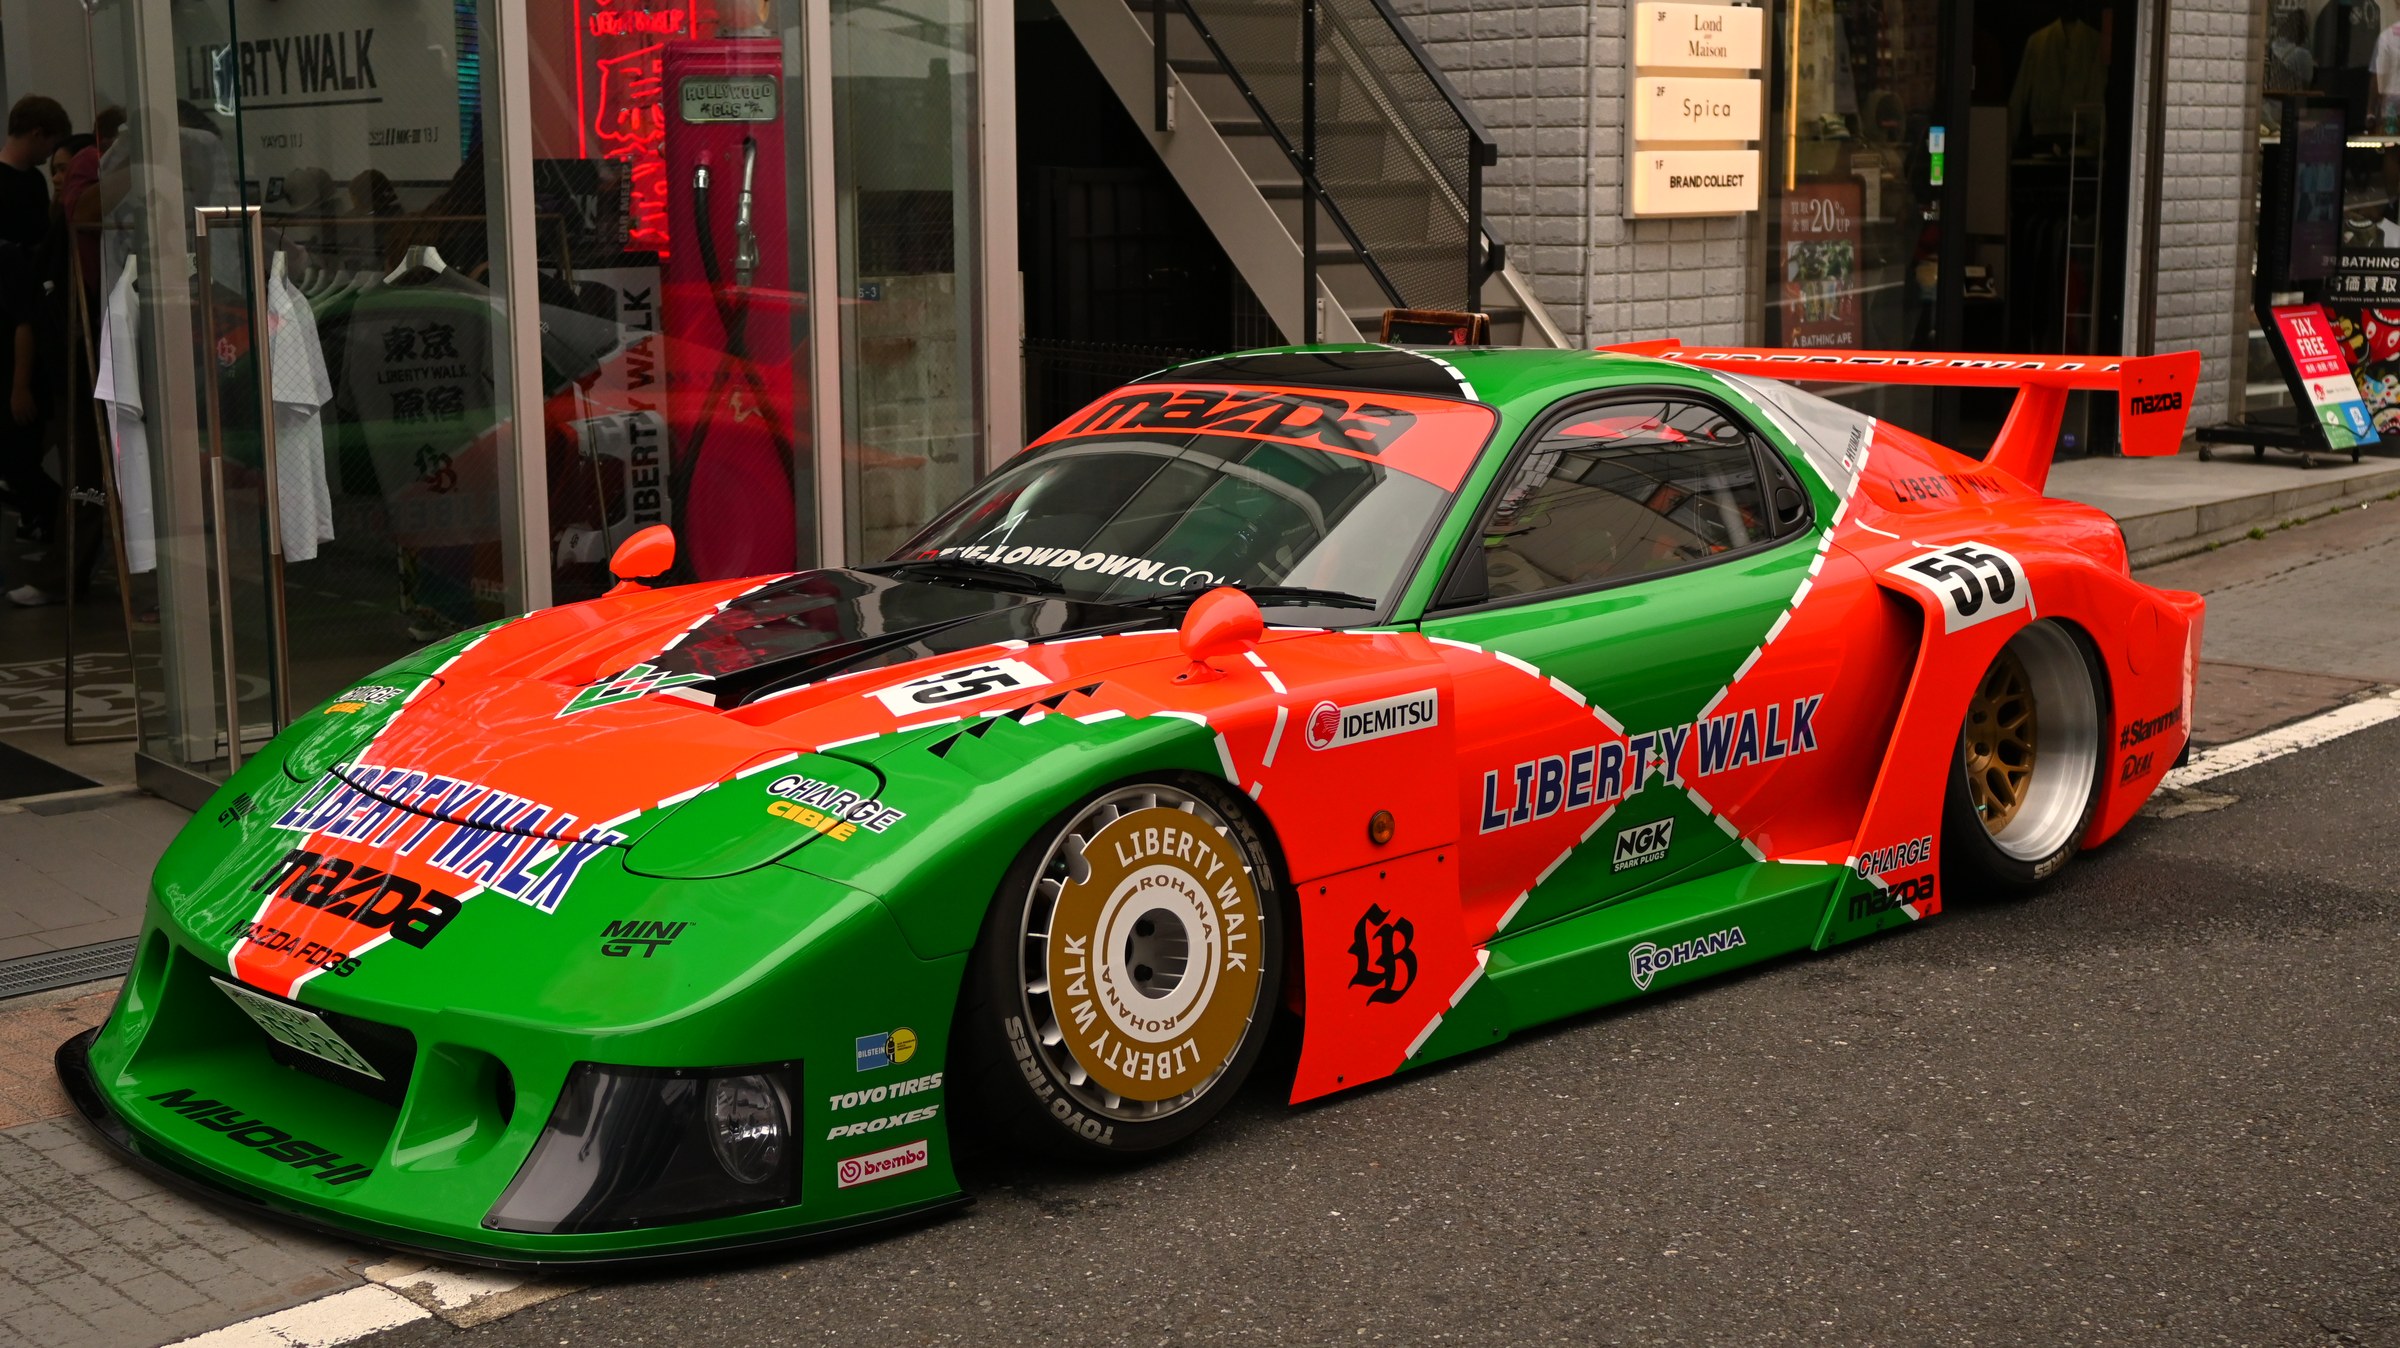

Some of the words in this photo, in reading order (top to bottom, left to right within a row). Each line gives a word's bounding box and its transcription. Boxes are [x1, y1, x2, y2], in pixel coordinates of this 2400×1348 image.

[1657, 11, 1667, 22] 3F
[1694, 13, 1723, 32] Lond
[294, 27, 378, 93] WALK
[1688, 39, 1728, 58] Maison
[685, 83, 772, 101] HOLLYWOOD
[711, 101, 741, 117] GAS
[1656, 86, 1666, 97] 2F
[1682, 97, 1731, 122] Spica
[1655, 159, 1664, 170] 1F
[1669, 175, 1702, 189] BRAND
[1703, 174, 1744, 188] COLLECT
[1836, 217, 1851, 233] UP
[1801, 333, 1835, 347] BATHING
[1837, 332, 1852, 345] APE
[2290, 317, 2317, 337] TAX
[2296, 335, 2329, 357] FREE
[1068, 390, 1418, 456] mazda
[2130, 391, 2182, 416] mazda
[1889, 474, 1968, 503] LIBERTY
[1962, 473, 2009, 495] WALK
[1909, 546, 2017, 617] 55
[1343, 698, 1434, 739] IDEMITSU
[1479, 722, 1692, 835] LIBERTY
[1698, 693, 1824, 777] WALK
[766, 774, 907, 834] CHARGE
[426, 789, 630, 915] WALK
[1616, 820, 1671, 861] NGK
[1857, 835, 1933, 880] CHARGE
[1614, 858, 1640, 873] SPARK
[1640, 850, 1665, 865] PLUGS
[250, 848, 462, 949] mazda
[1114, 827, 1225, 881] LIBERTY
[1216, 876, 1250, 973] WALK
[1138, 874, 1212, 941] ROHANA
[1848, 873, 1935, 923] mazda
[225, 918, 300, 955] MAZDA
[295, 941, 362, 979] FD3S
[600, 920, 688, 940] MINI
[601, 939, 673, 958] GT
[1635, 926, 1746, 977] ROHANA
[1064, 934, 1098, 1036] WALK
[1101, 965, 1178, 1033] ROHANA
[858, 1046, 886, 1058] BILSTEIN
[1004, 1015, 1051, 1104] TIRES
[1089, 1030, 1201, 1082] LIBERTY
[829, 1086, 887, 1111] TOYO
[889, 1072, 943, 1098] TIRES
[146, 1088, 374, 1187] MIYOSHI
[826, 1104, 940, 1141] PROXES
[1049, 1093, 1116, 1147] TOYO
[864, 1149, 926, 1176] brembo
